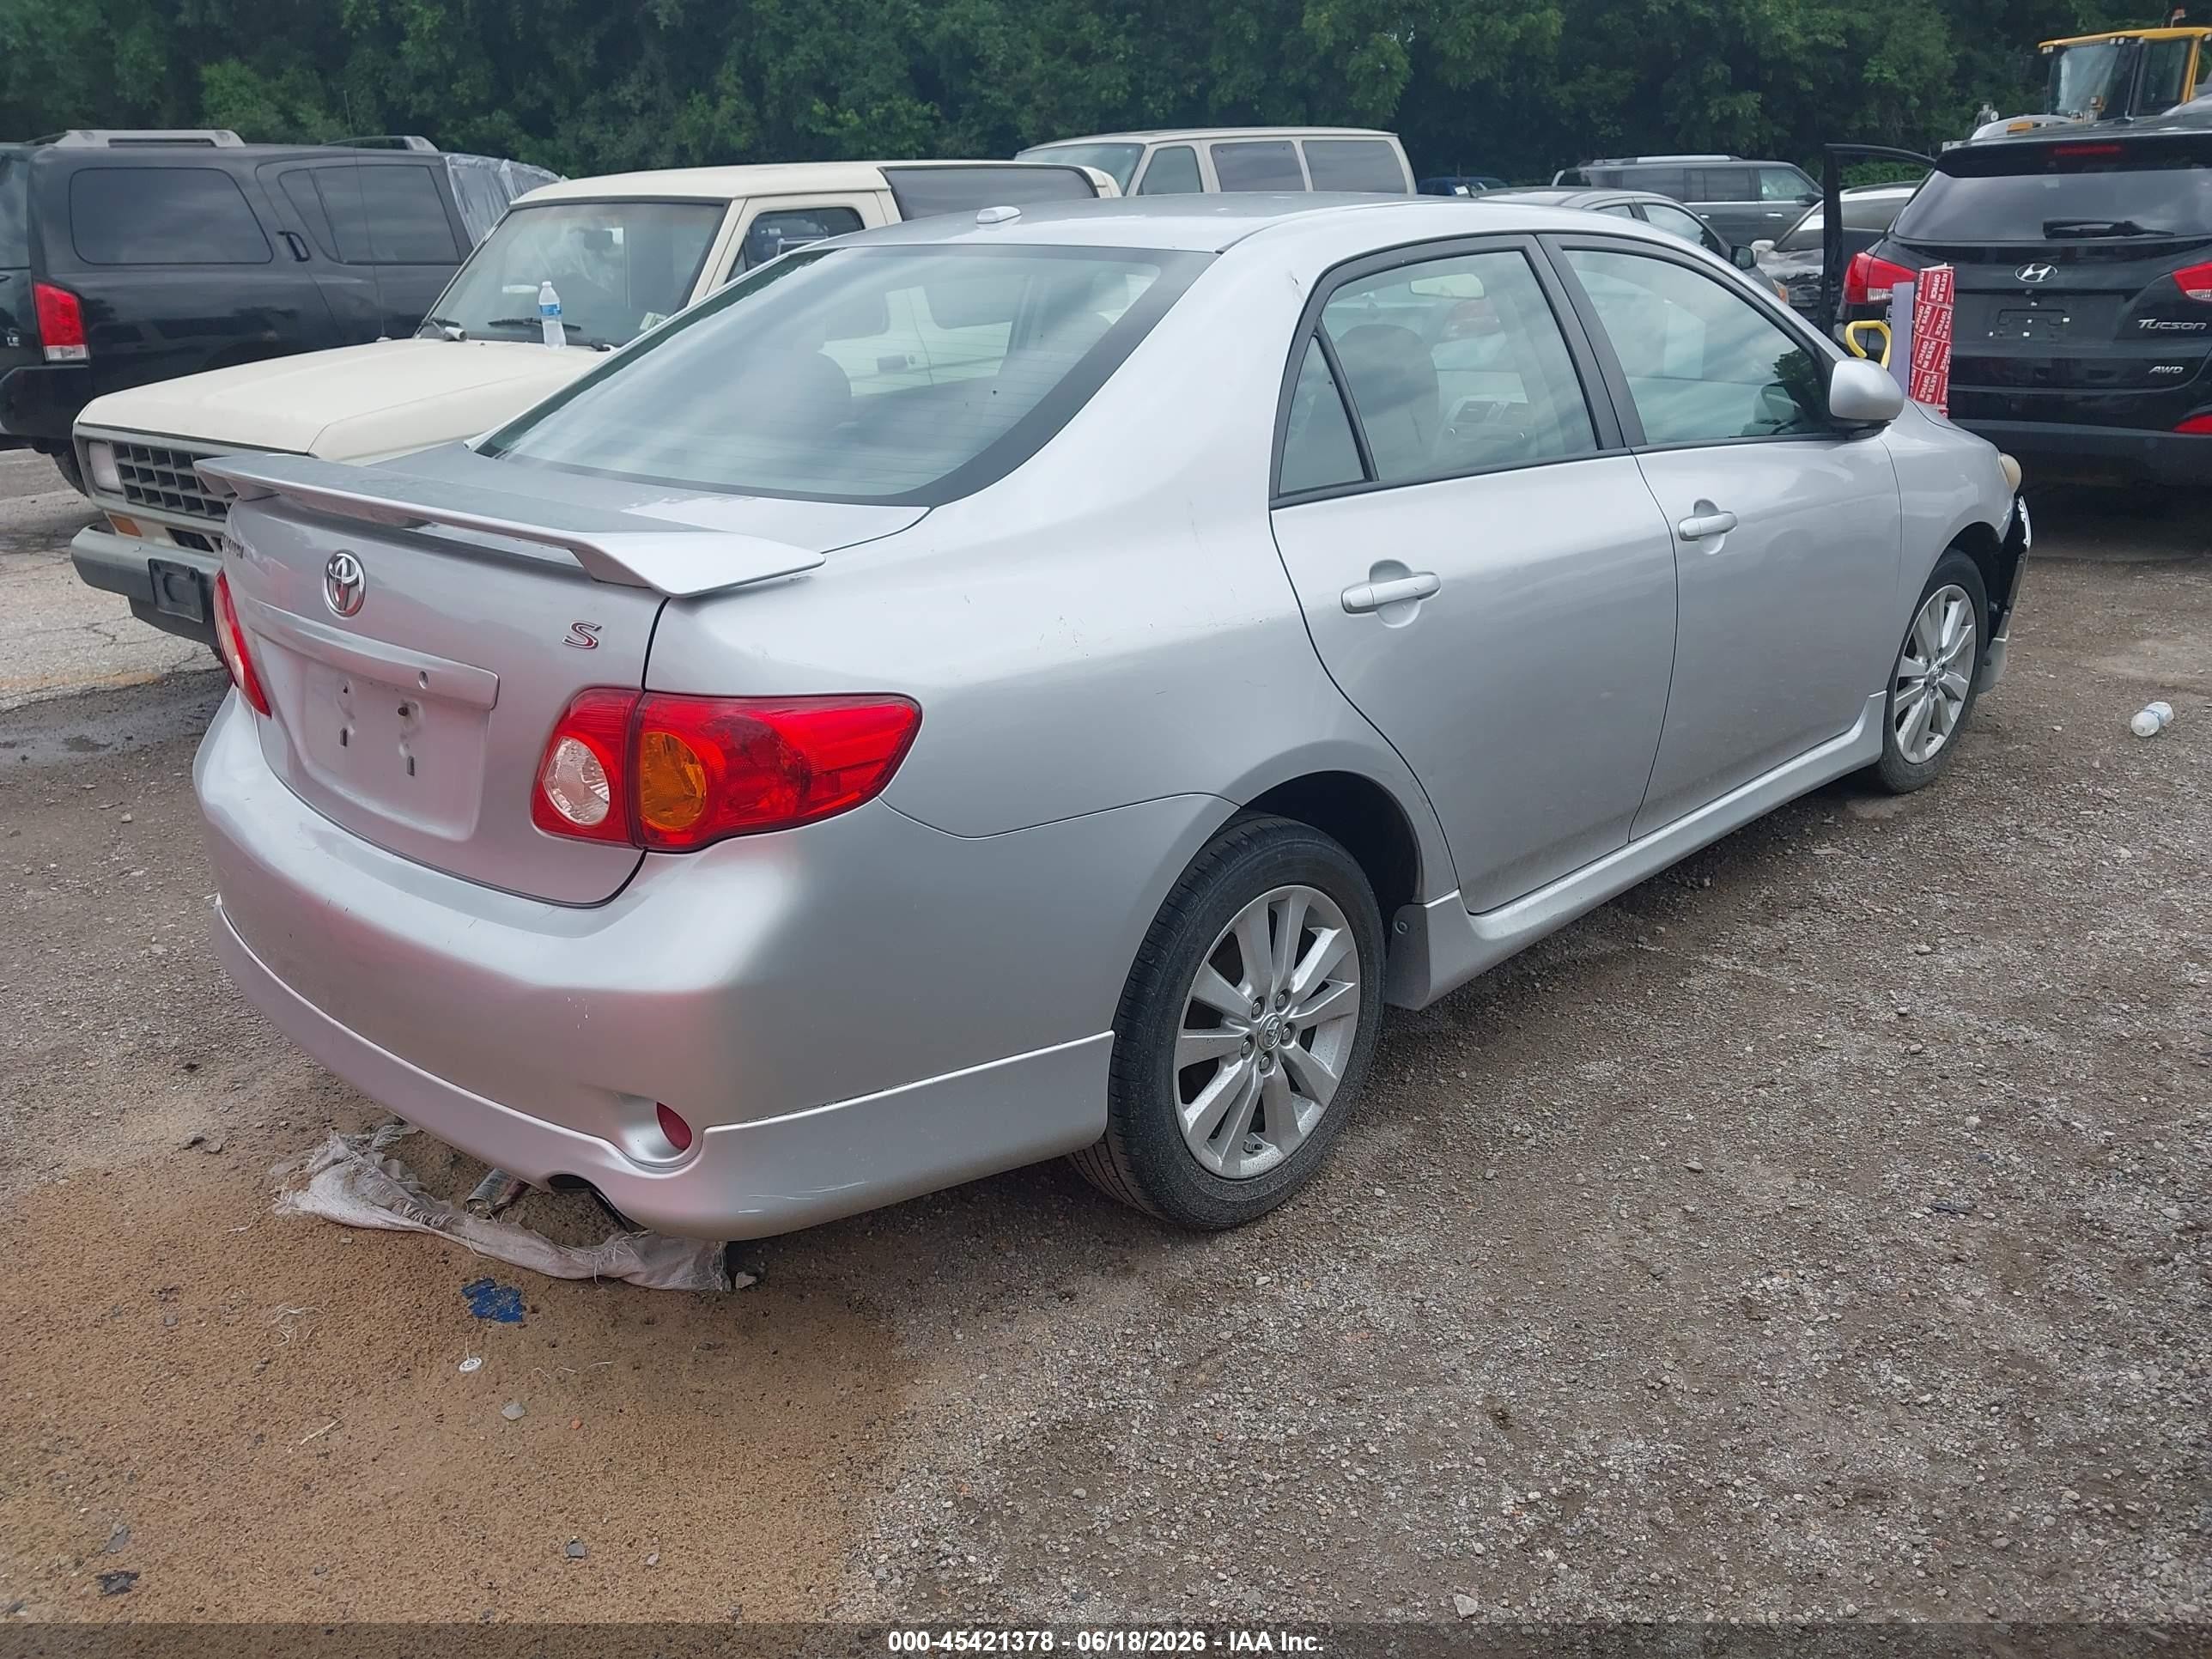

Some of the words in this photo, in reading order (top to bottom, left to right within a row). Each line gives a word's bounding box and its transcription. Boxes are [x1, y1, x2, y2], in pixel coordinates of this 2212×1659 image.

[1929, 274, 1941, 300] OFFICE
[1940, 273, 1948, 292] KEYS
[1937, 294, 1944, 302] IN
[1921, 305, 1932, 324] KEYS
[1935, 310, 1948, 337] OFFICE
[1918, 325, 1925, 333] IN
[1917, 341, 1929, 365] OFFICE
[1925, 341, 1937, 360] KEYS
[1922, 360, 1929, 369] IN
[1918, 375, 1930, 399] OFFICE
[1928, 374, 1938, 393] KEYS
[1925, 394, 1932, 403] IN
[562, 620, 602, 650] S
